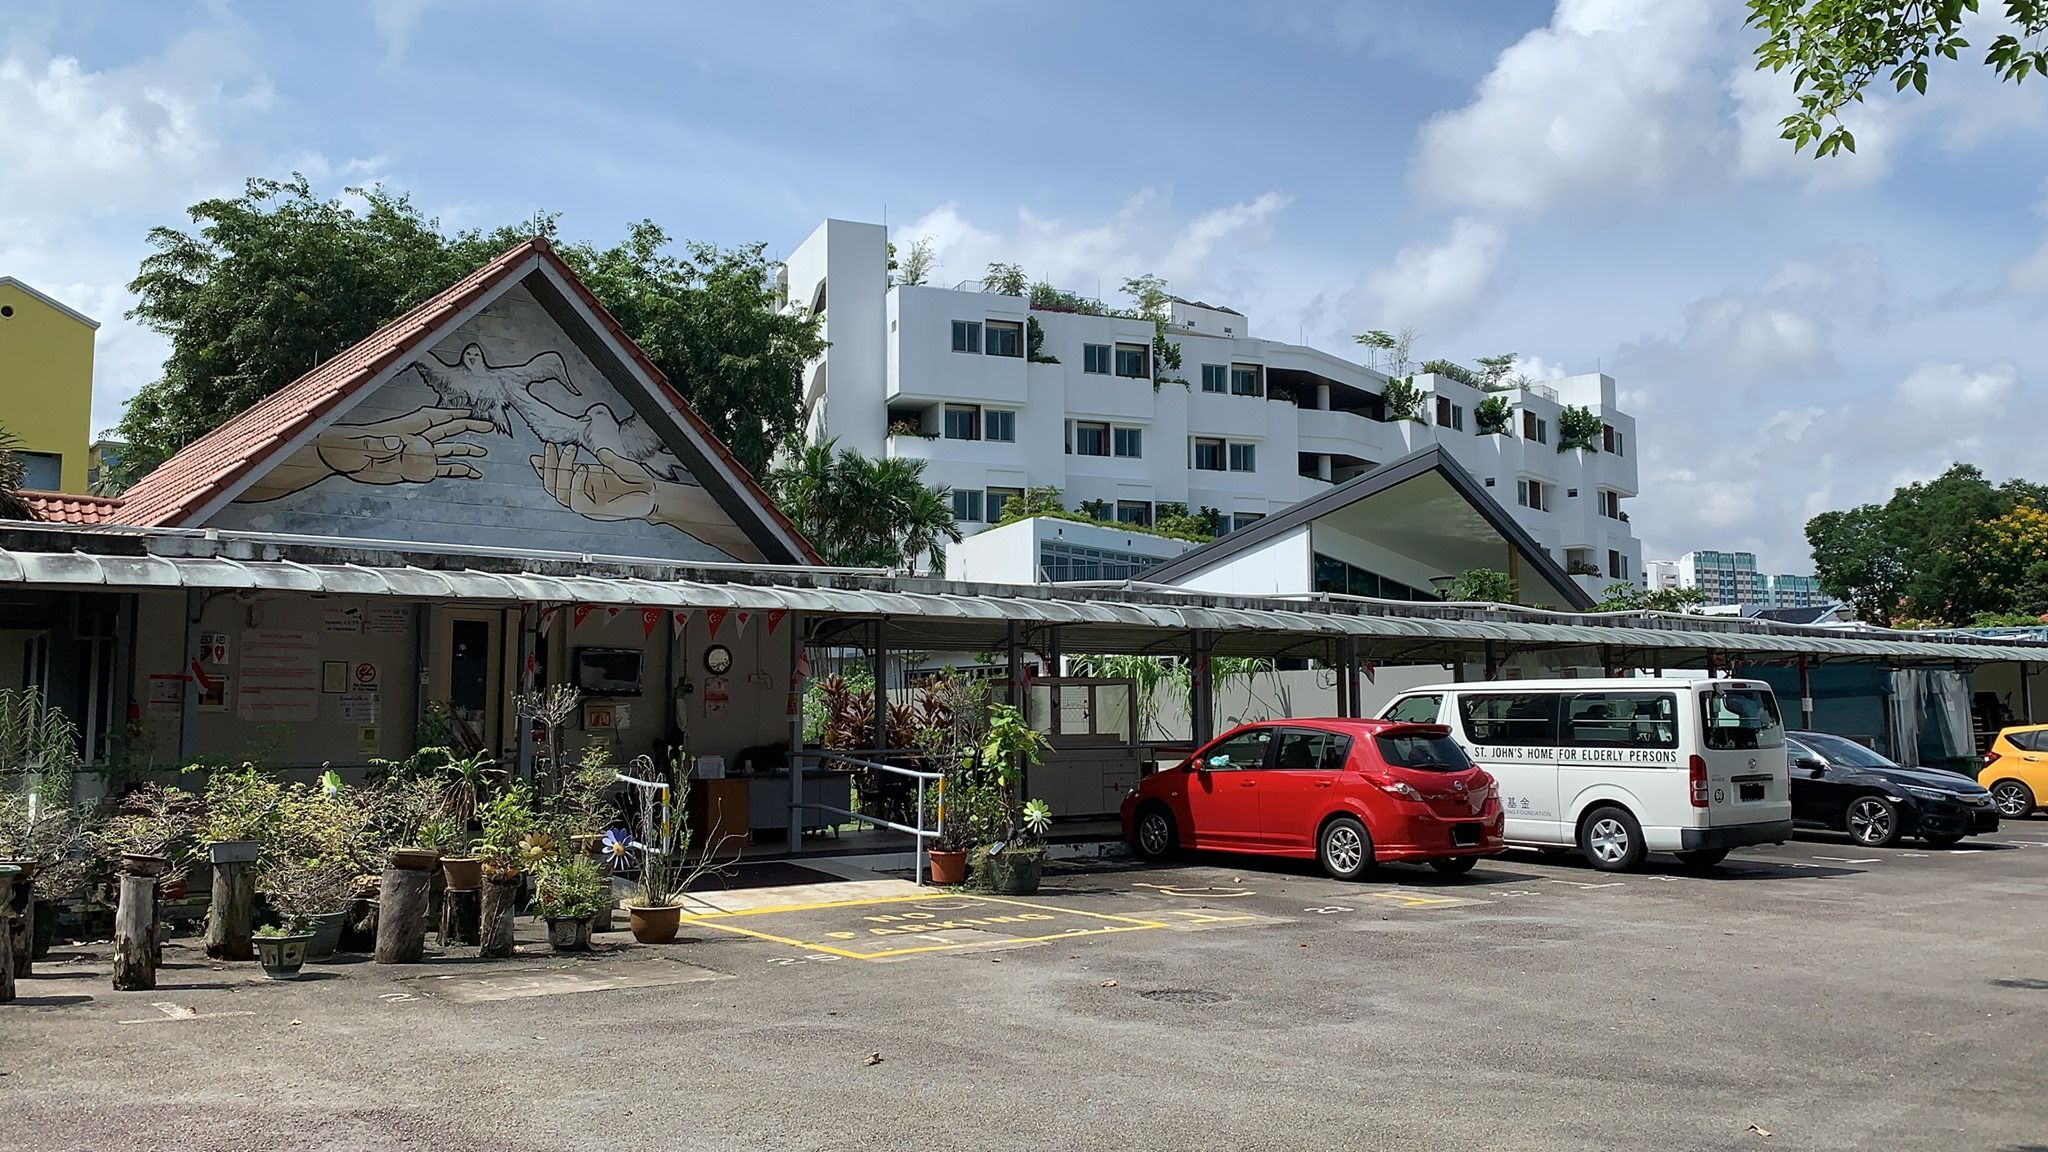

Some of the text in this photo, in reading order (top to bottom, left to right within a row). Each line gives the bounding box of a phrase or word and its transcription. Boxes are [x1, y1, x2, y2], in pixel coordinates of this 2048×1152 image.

[1474, 747, 1676, 763] ST. JOHN'S HOME FOR ELDERLY PERSONS
[1502, 797, 1530, 809] 基金
[863, 911, 935, 923] NO
[826, 912, 1055, 939] PARKING
